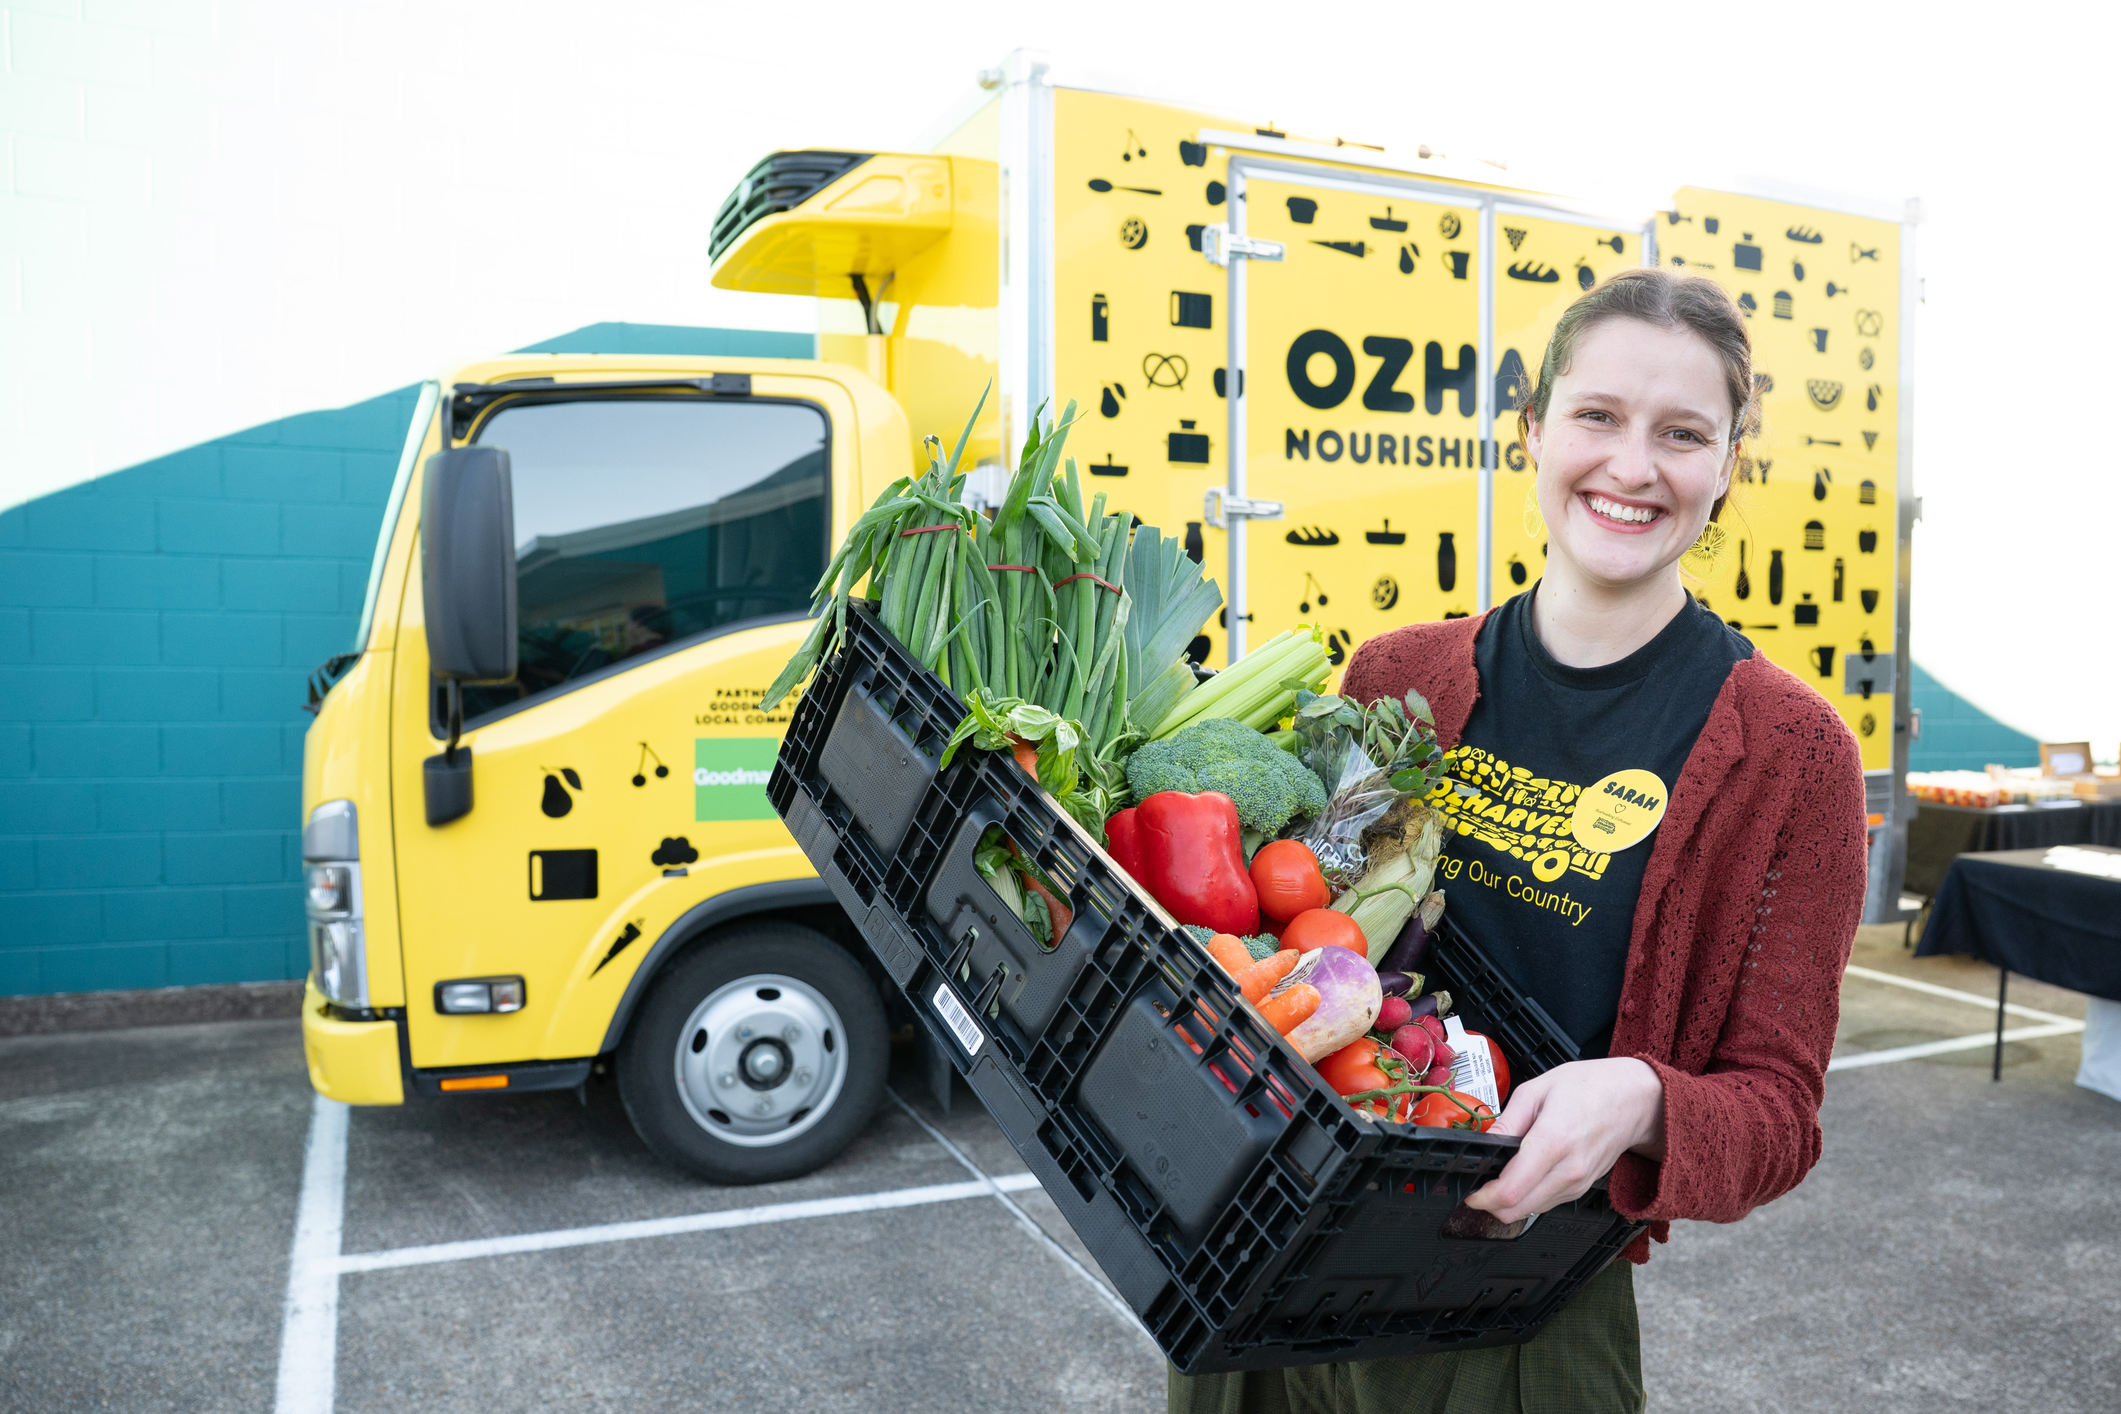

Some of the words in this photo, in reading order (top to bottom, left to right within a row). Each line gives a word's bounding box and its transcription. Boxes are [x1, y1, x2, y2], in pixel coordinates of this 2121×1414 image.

[1286, 329, 1530, 419] OZHA
[695, 715, 738, 724] LOCAL
[745, 715, 792, 724] COMM
[1429, 776, 1573, 837] OZHARVES
[1603, 781, 1660, 811] SARAH
[1437, 852, 1464, 880] ng
[1468, 860, 1502, 890] Our
[1506, 875, 1592, 927] Country
